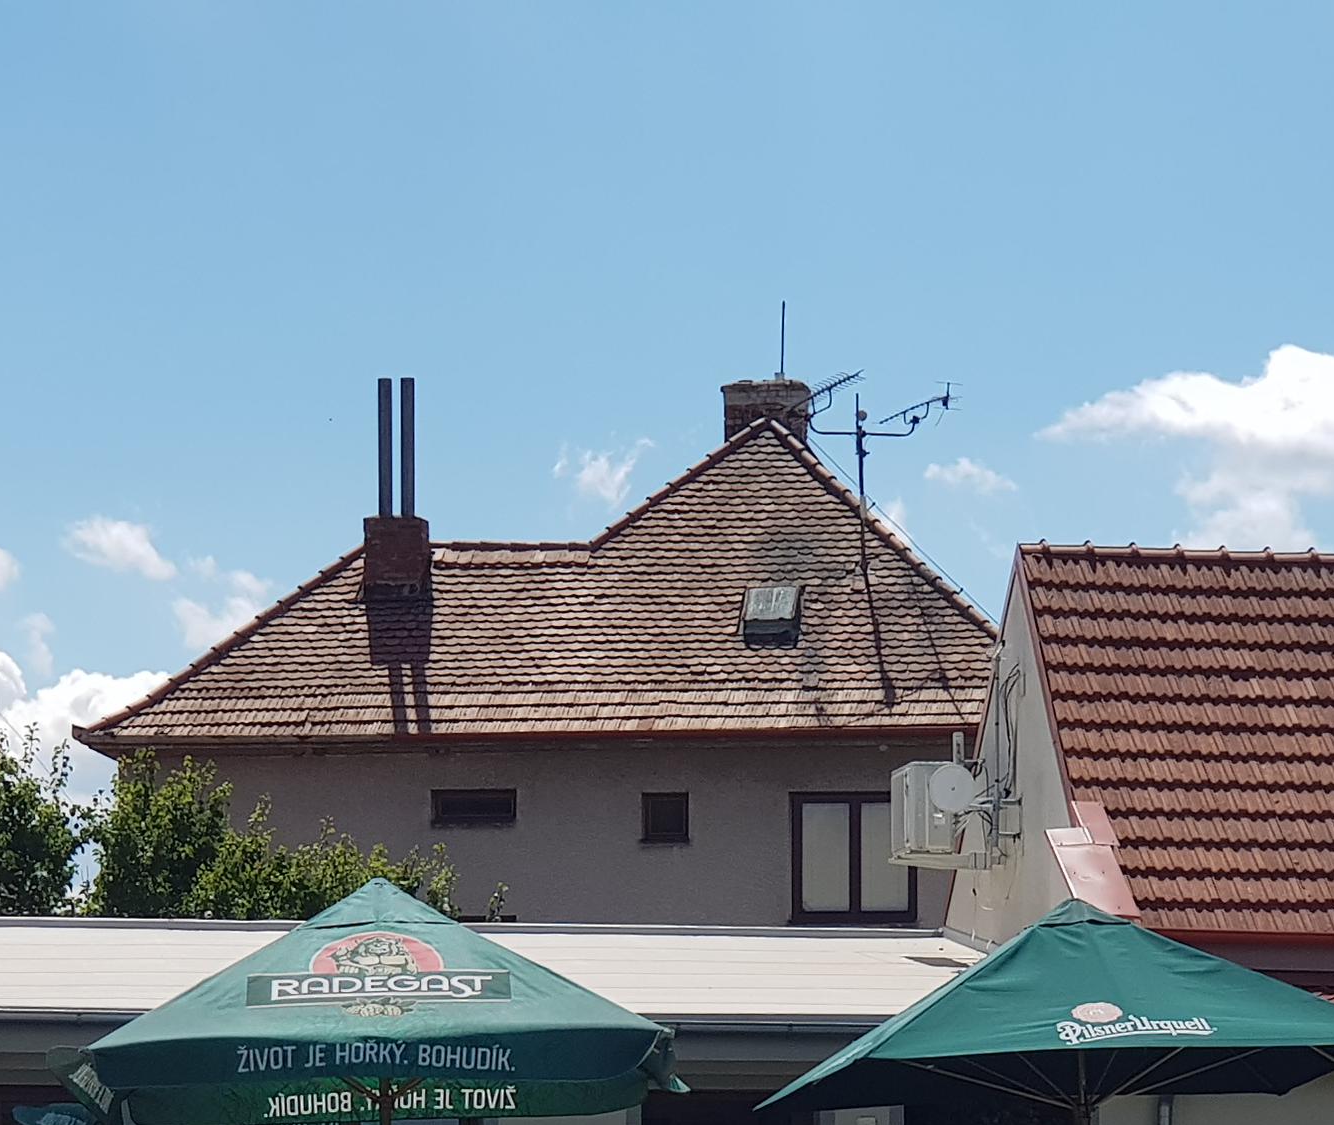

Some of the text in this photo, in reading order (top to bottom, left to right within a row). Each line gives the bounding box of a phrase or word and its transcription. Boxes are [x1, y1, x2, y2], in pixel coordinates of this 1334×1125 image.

[270, 974, 493, 1001] RADEGAST
[1056, 1014, 1214, 1045] Pilsner Urquell
[236, 1040, 516, 1074] ŽIVOT JE HOŘKÝ. BOHUDÍK.
